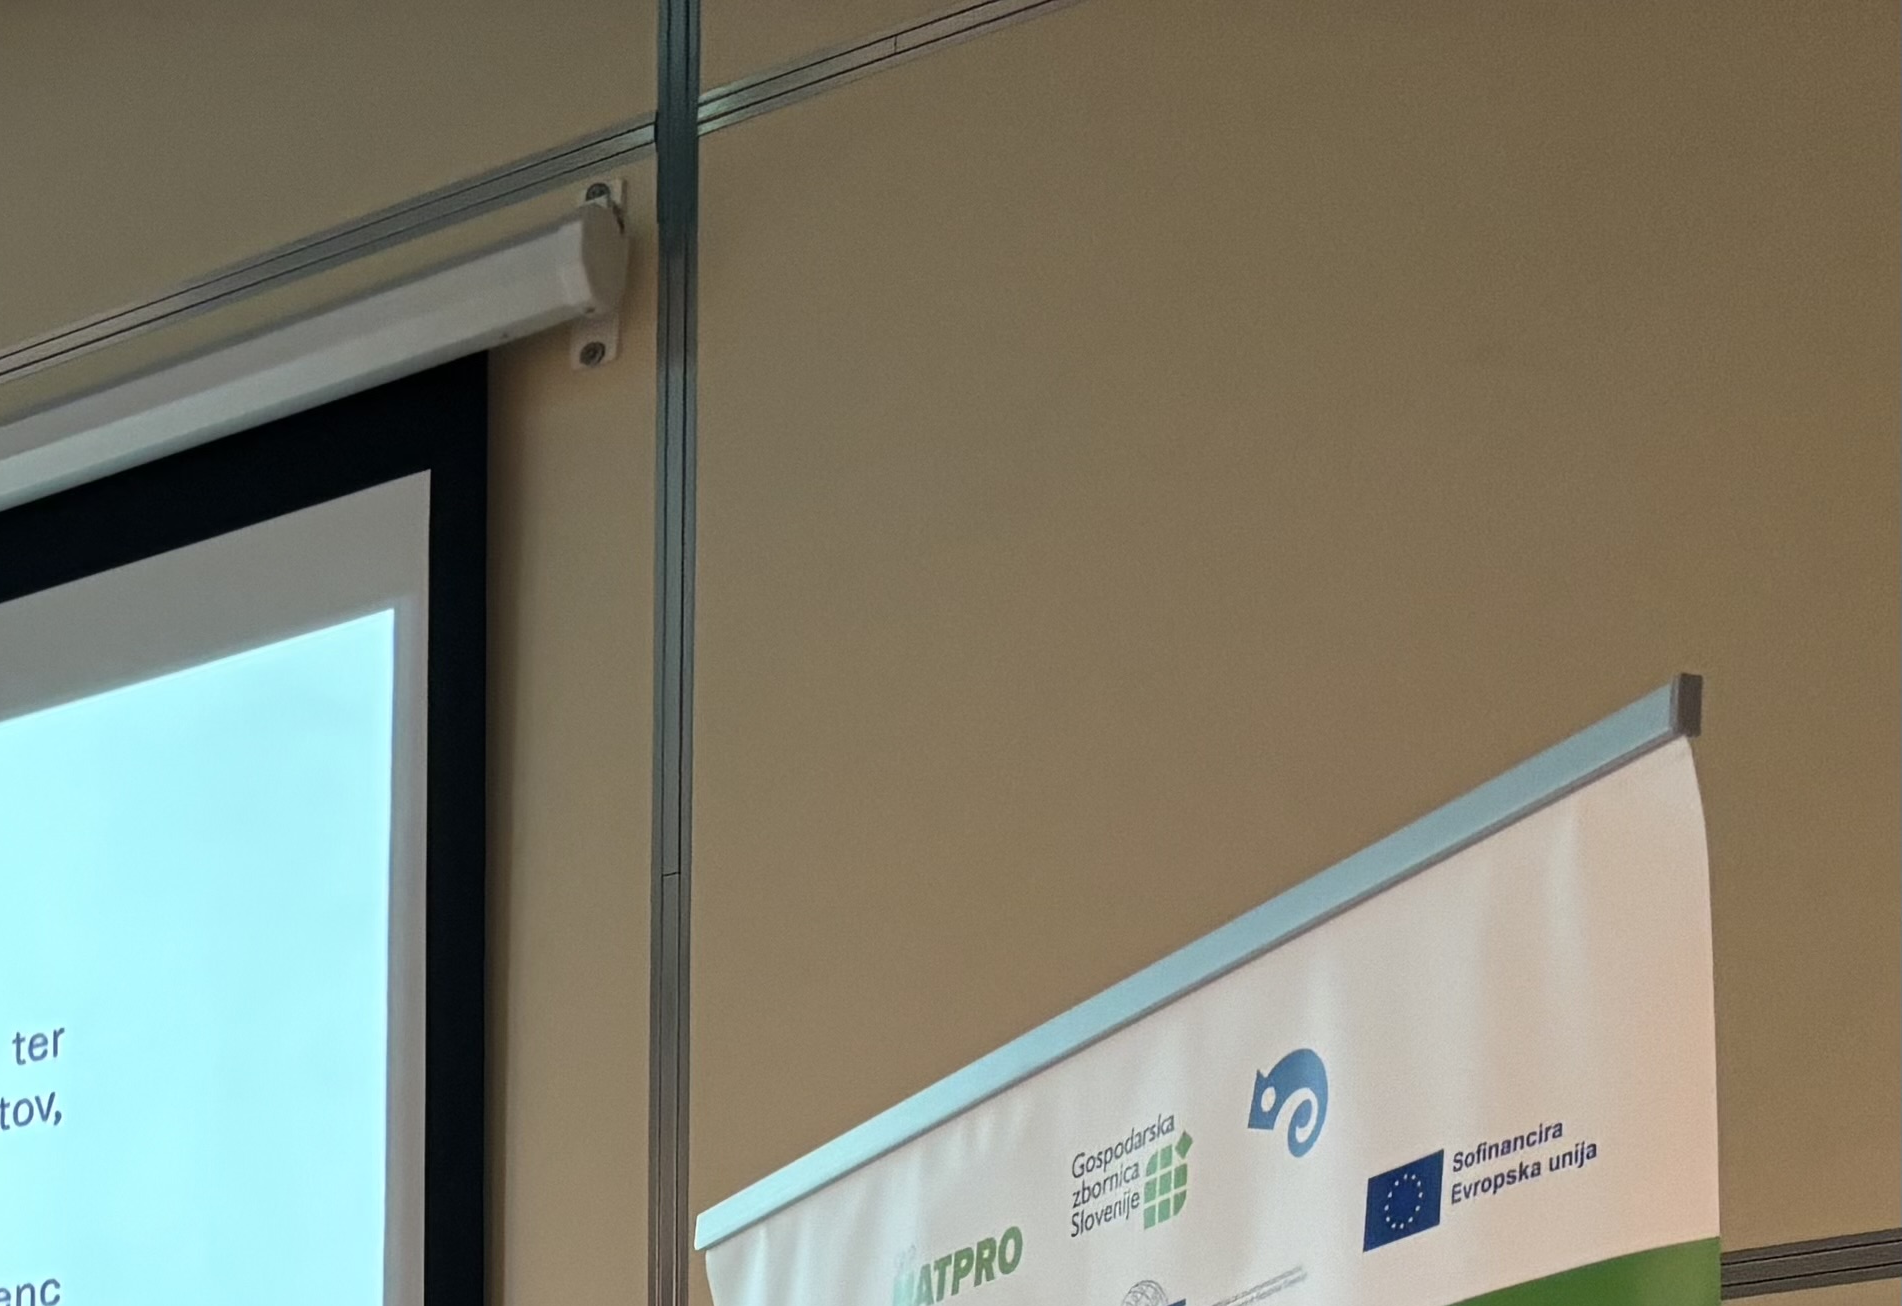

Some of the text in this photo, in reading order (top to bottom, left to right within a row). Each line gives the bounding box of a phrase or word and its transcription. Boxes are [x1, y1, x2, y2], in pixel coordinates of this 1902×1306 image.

[12, 1028, 65, 1065] ter
[1071, 1113, 1175, 1178] Gospodarska
[1452, 1119, 1565, 1174] Sofinancira
[1071, 1160, 1140, 1209] zbornica
[1450, 1139, 1598, 1206] Evropska unija
[1070, 1190, 1141, 1238] Slovenije
